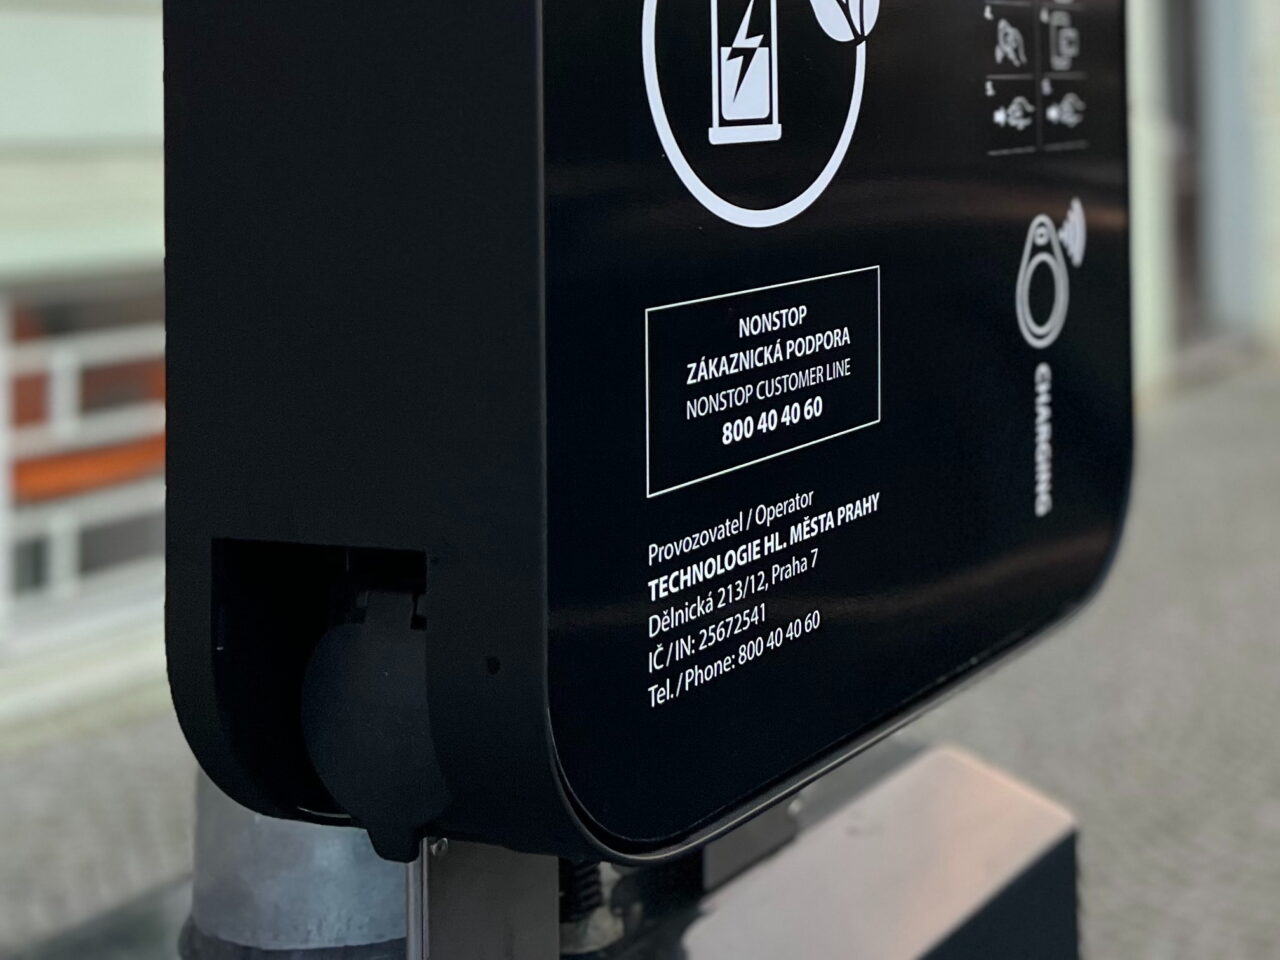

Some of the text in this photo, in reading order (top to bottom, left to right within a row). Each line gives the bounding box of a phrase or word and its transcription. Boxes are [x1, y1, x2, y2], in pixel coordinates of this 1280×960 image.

[738, 305, 807, 338] NONSTOP
[686, 326, 851, 385] ZÁKAZNICKÁ PODPORA
[686, 357, 851, 420] NONSTOP CUSTOMER LINE
[722, 396, 823, 445] 800 40 40 60
[648, 511, 744, 566] Provozovatel
[755, 491, 814, 527] Operator
[648, 492, 880, 602] TECHNOLOGIE HL. MĚSTA PRAHY
[648, 548, 819, 638] Dělnická 213/12, Praha 7
[699, 603, 766, 651] 25672541
[738, 637, 764, 666] 800
[766, 628, 783, 650] 40
[786, 619, 802, 640] 40
[804, 610, 821, 633] 60
